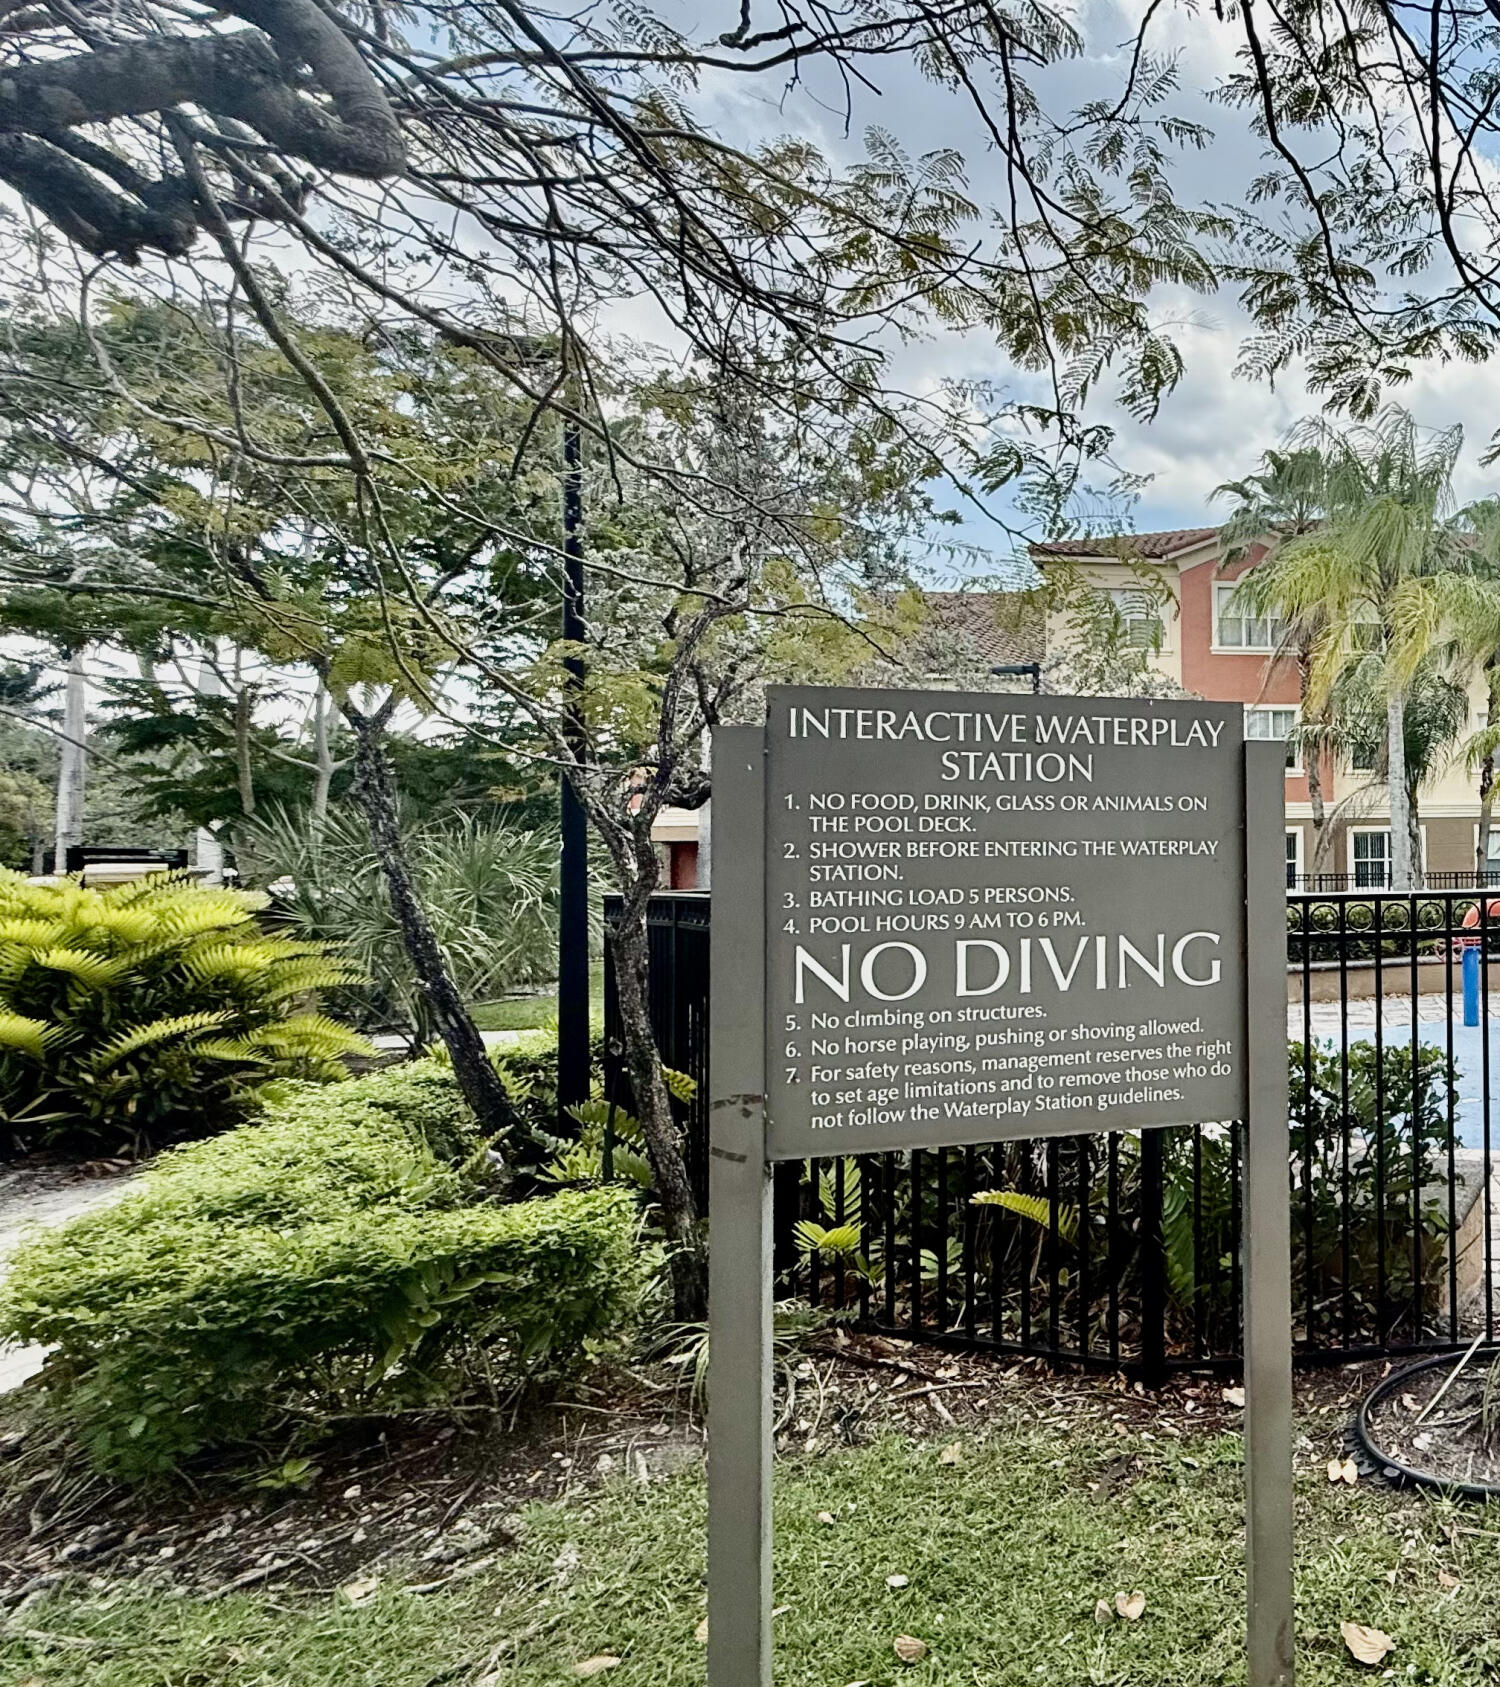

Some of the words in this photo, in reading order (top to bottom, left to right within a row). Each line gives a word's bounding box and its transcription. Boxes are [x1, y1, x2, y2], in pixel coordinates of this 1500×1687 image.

[789, 707, 1027, 743] INTERACTIVE
[1035, 714, 1225, 748] WATERPLAY
[941, 750, 1093, 783] STATION
[784, 793, 800, 810] 1.
[809, 793, 846, 810] NO
[851, 793, 919, 814] FOOD,
[924, 794, 992, 814] DRINK,
[995, 794, 1056, 811] GLASS
[1059, 795, 1089, 811] OR
[1091, 795, 1174, 812] ANIMALS
[1177, 795, 1208, 812] ON
[808, 816, 849, 833] THE
[854, 815, 914, 833] POOL
[918, 816, 977, 833] DECK.
[783, 842, 800, 859] 2.
[809, 841, 902, 859] SHOWER
[906, 841, 980, 858] BEFORE
[984, 840, 1078, 857] ENTERING
[1080, 840, 1117, 856] THE
[1119, 840, 1219, 856] WATERPLAY
[809, 864, 904, 882] STATION.
[782, 892, 801, 909] 3.
[809, 889, 903, 908] BATHING
[908, 888, 965, 906] LOAD
[968, 888, 980, 905] 5
[984, 886, 1076, 904] PERSONS.
[782, 918, 800, 935] 4.
[809, 916, 872, 934] POOL
[875, 913, 950, 932] HOURS
[954, 913, 966, 930] 9
[968, 912, 1002, 929] AM
[1005, 911, 1034, 929] TO
[1037, 911, 1049, 928] 6
[1052, 910, 1086, 927] PM.
[794, 941, 927, 1004] NO
[955, 931, 1222, 997] DIVING
[784, 1014, 802, 1032] 5.
[811, 1012, 840, 1030] No
[844, 1008, 925, 1030] climbing
[928, 1010, 953, 1024] on
[956, 1005, 1048, 1023] structures.
[785, 1040, 802, 1058] 6.
[811, 1038, 840, 1056] No
[844, 1036, 898, 1055] horse
[901, 1031, 971, 1056] playing,
[975, 1027, 1046, 1052] pushing
[1048, 1028, 1068, 1042] or
[1070, 1021, 1136, 1043] shoving
[1138, 1016, 1205, 1037] allowed.
[785, 1067, 801, 1084] 7.
[811, 1065, 842, 1083] For
[845, 1060, 900, 1083] safety
[904, 1059, 977, 1077] reasons,
[981, 1049, 1092, 1074] management
[1095, 1047, 1163, 1064] reserves
[1165, 1042, 1193, 1059] the
[1195, 1039, 1232, 1061] right
[810, 1090, 831, 1106] to
[834, 1087, 863, 1105] set
[866, 1087, 900, 1107] age
[904, 1078, 997, 1099] limitations
[1000, 1073, 1033, 1092] and
[1036, 1074, 1055, 1090] to
[1058, 1071, 1122, 1088] remove
[1124, 1065, 1170, 1083] those
[1172, 1061, 1208, 1079] who
[1210, 1059, 1232, 1077] do
[811, 1112, 844, 1129] not
[847, 1106, 907, 1127] follow
[909, 1103, 940, 1121] the
[943, 1096, 1032, 1120] Waterplay
[1034, 1092, 1093, 1112] Station
[1097, 1085, 1185, 1112] guidelines.
